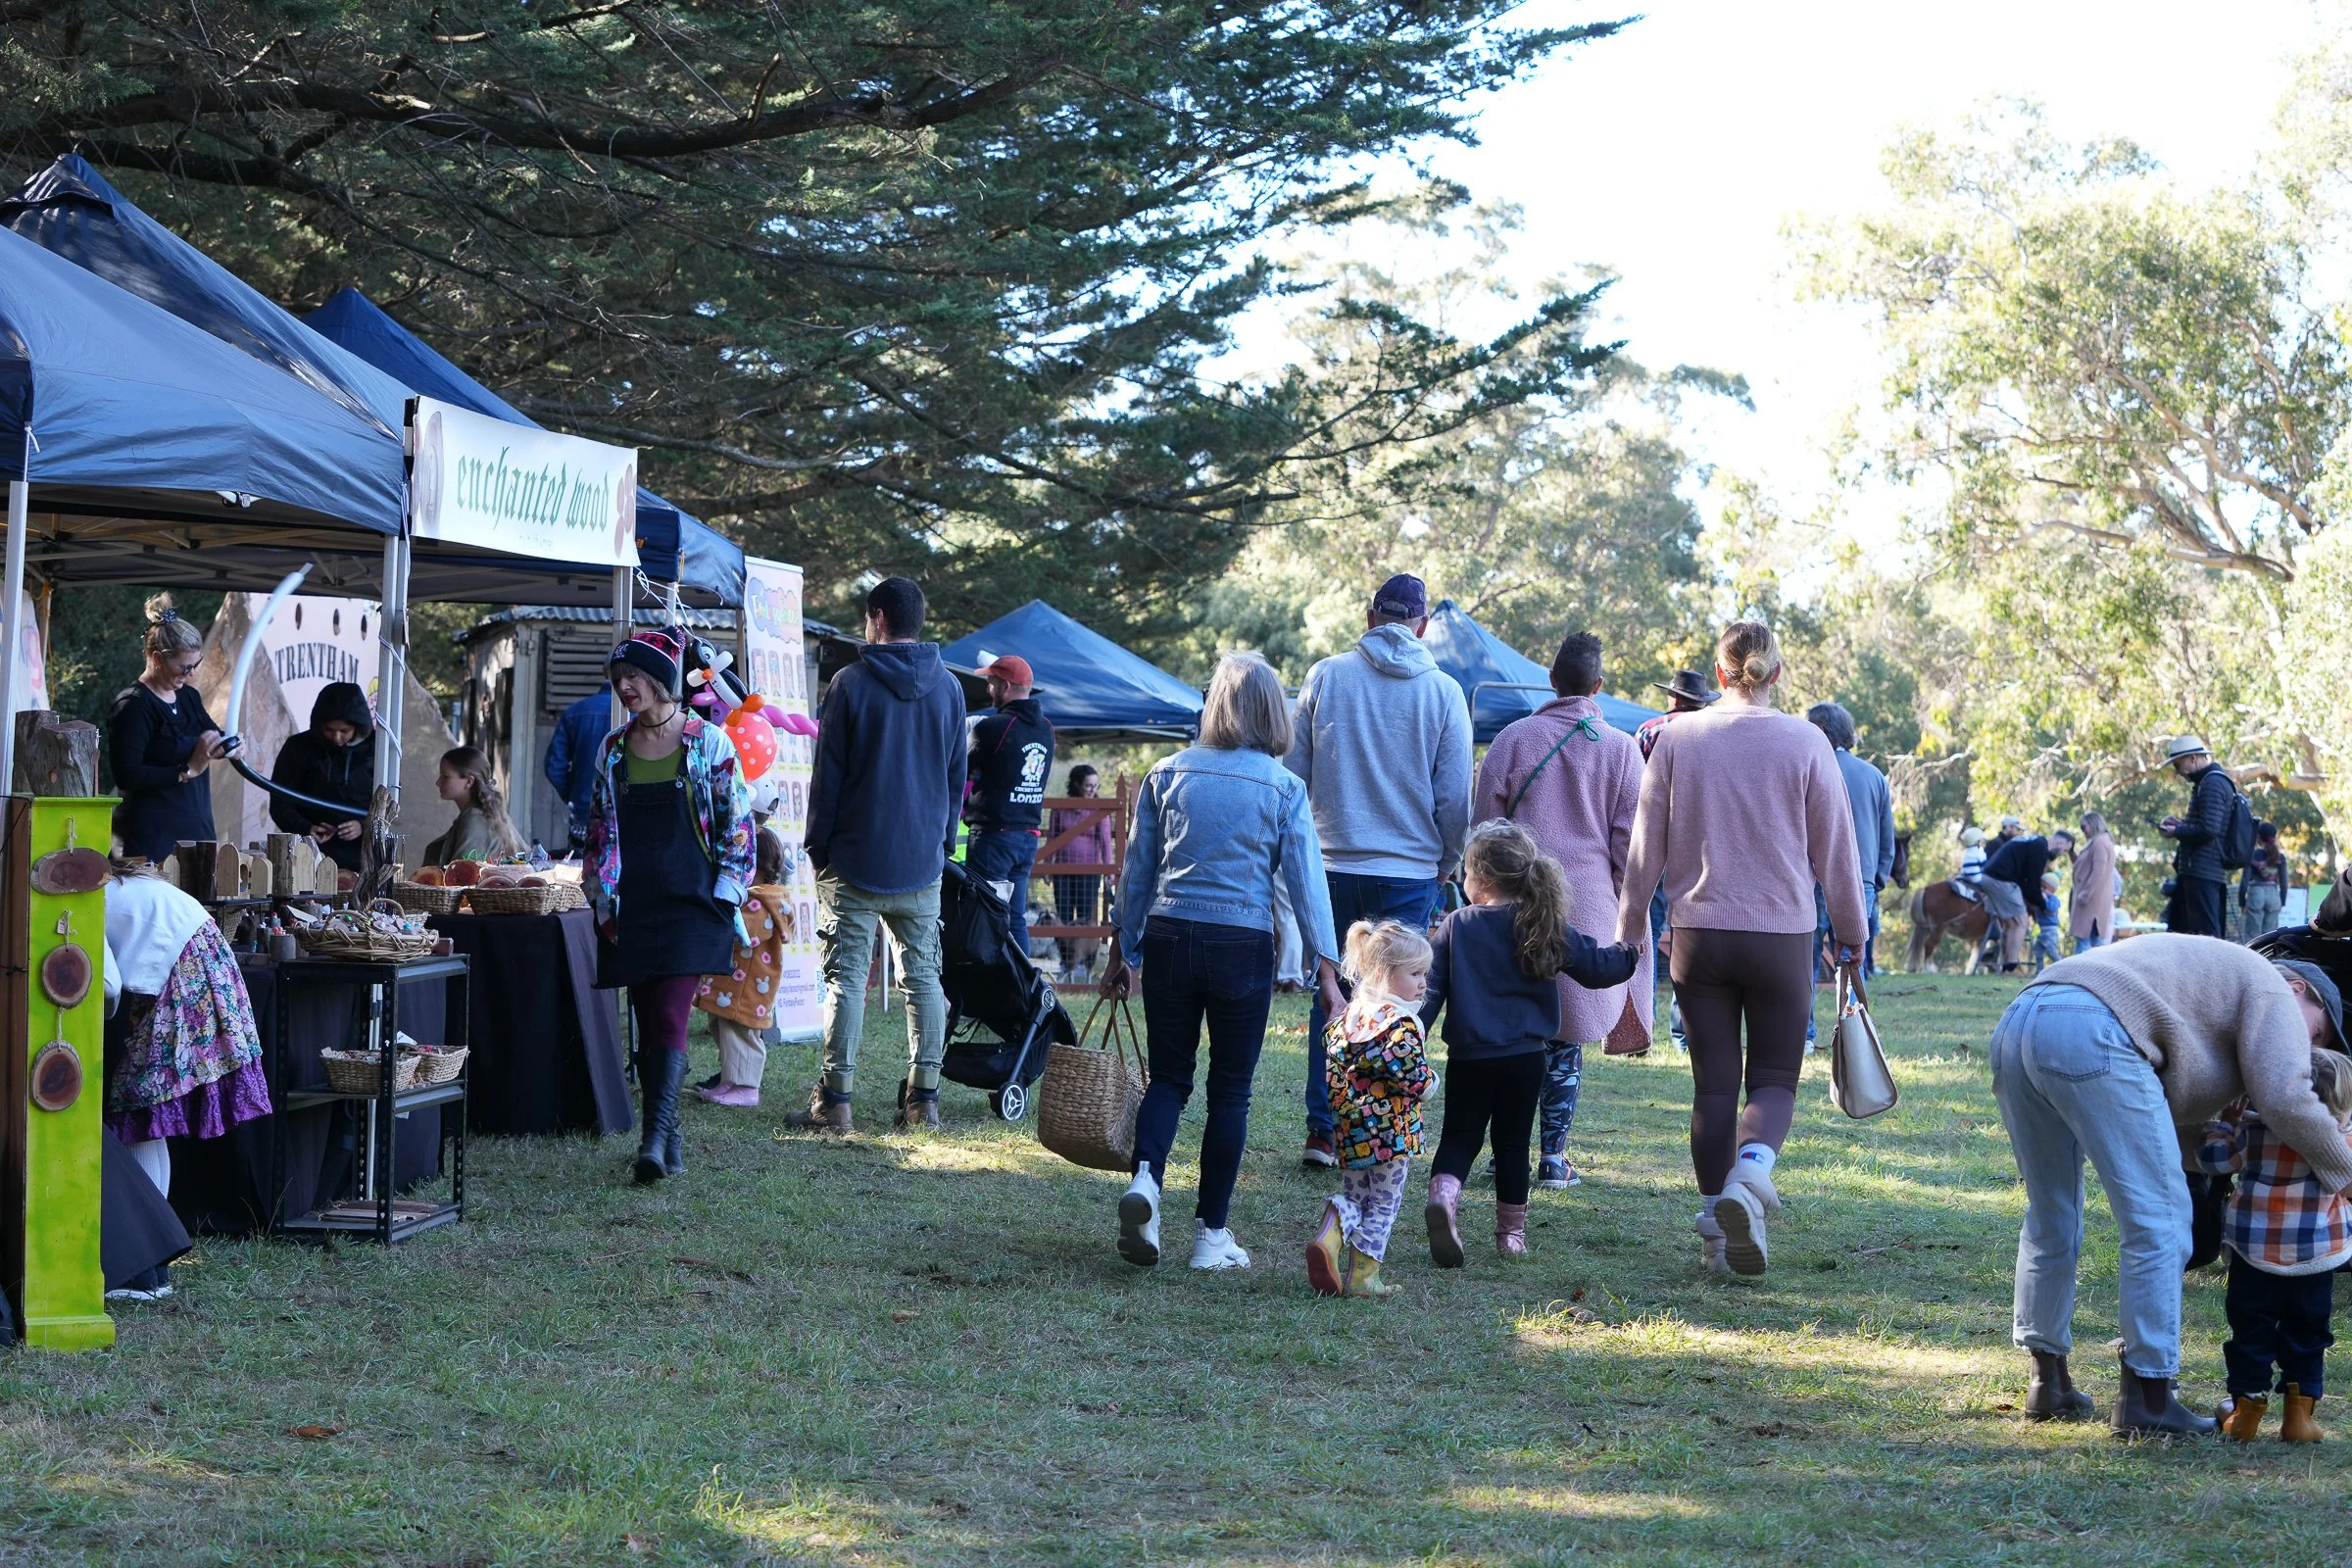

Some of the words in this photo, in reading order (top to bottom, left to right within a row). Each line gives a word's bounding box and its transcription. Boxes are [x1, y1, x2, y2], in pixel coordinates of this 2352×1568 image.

[457, 446, 567, 530] enchanted
[565, 467, 610, 532] wood
[274, 642, 360, 685] TRENTHAM
